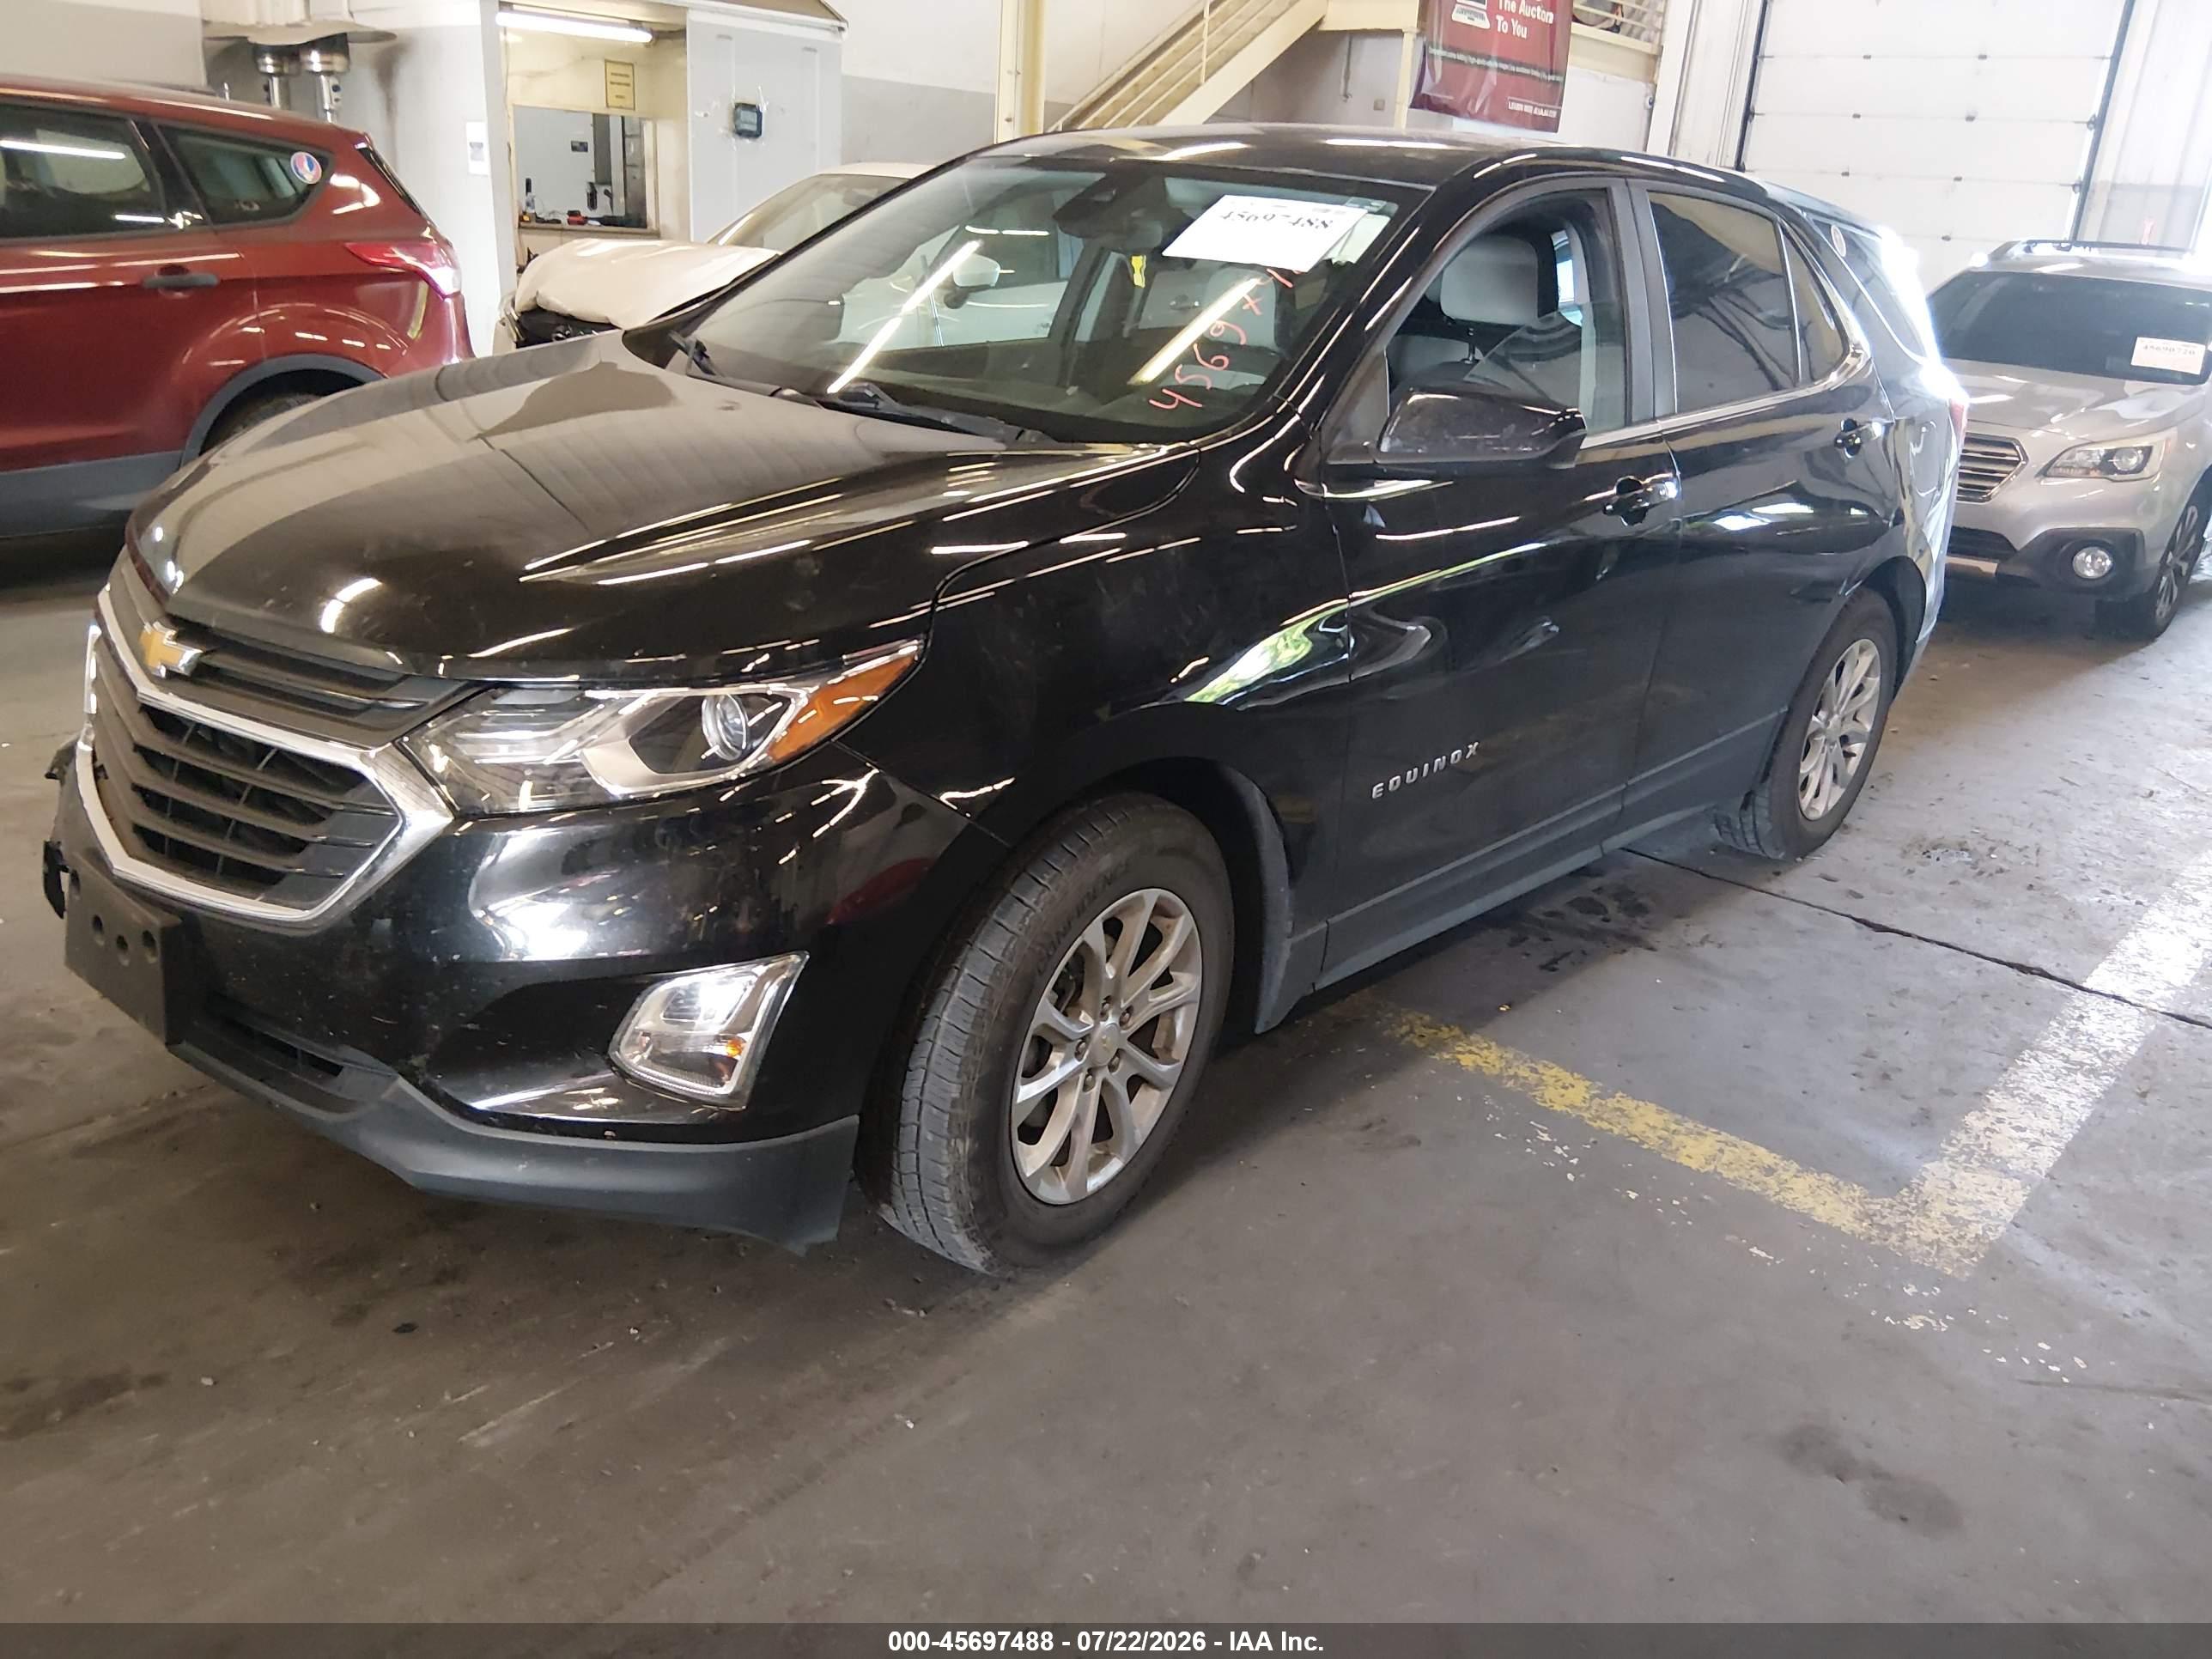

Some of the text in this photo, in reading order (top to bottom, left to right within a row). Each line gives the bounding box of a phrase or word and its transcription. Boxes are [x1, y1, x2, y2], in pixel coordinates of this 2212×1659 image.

[1519, 0, 1554, 24] Aucton
[1496, 15, 1528, 39] To You
[1371, 741, 1480, 799] EQUINOX
